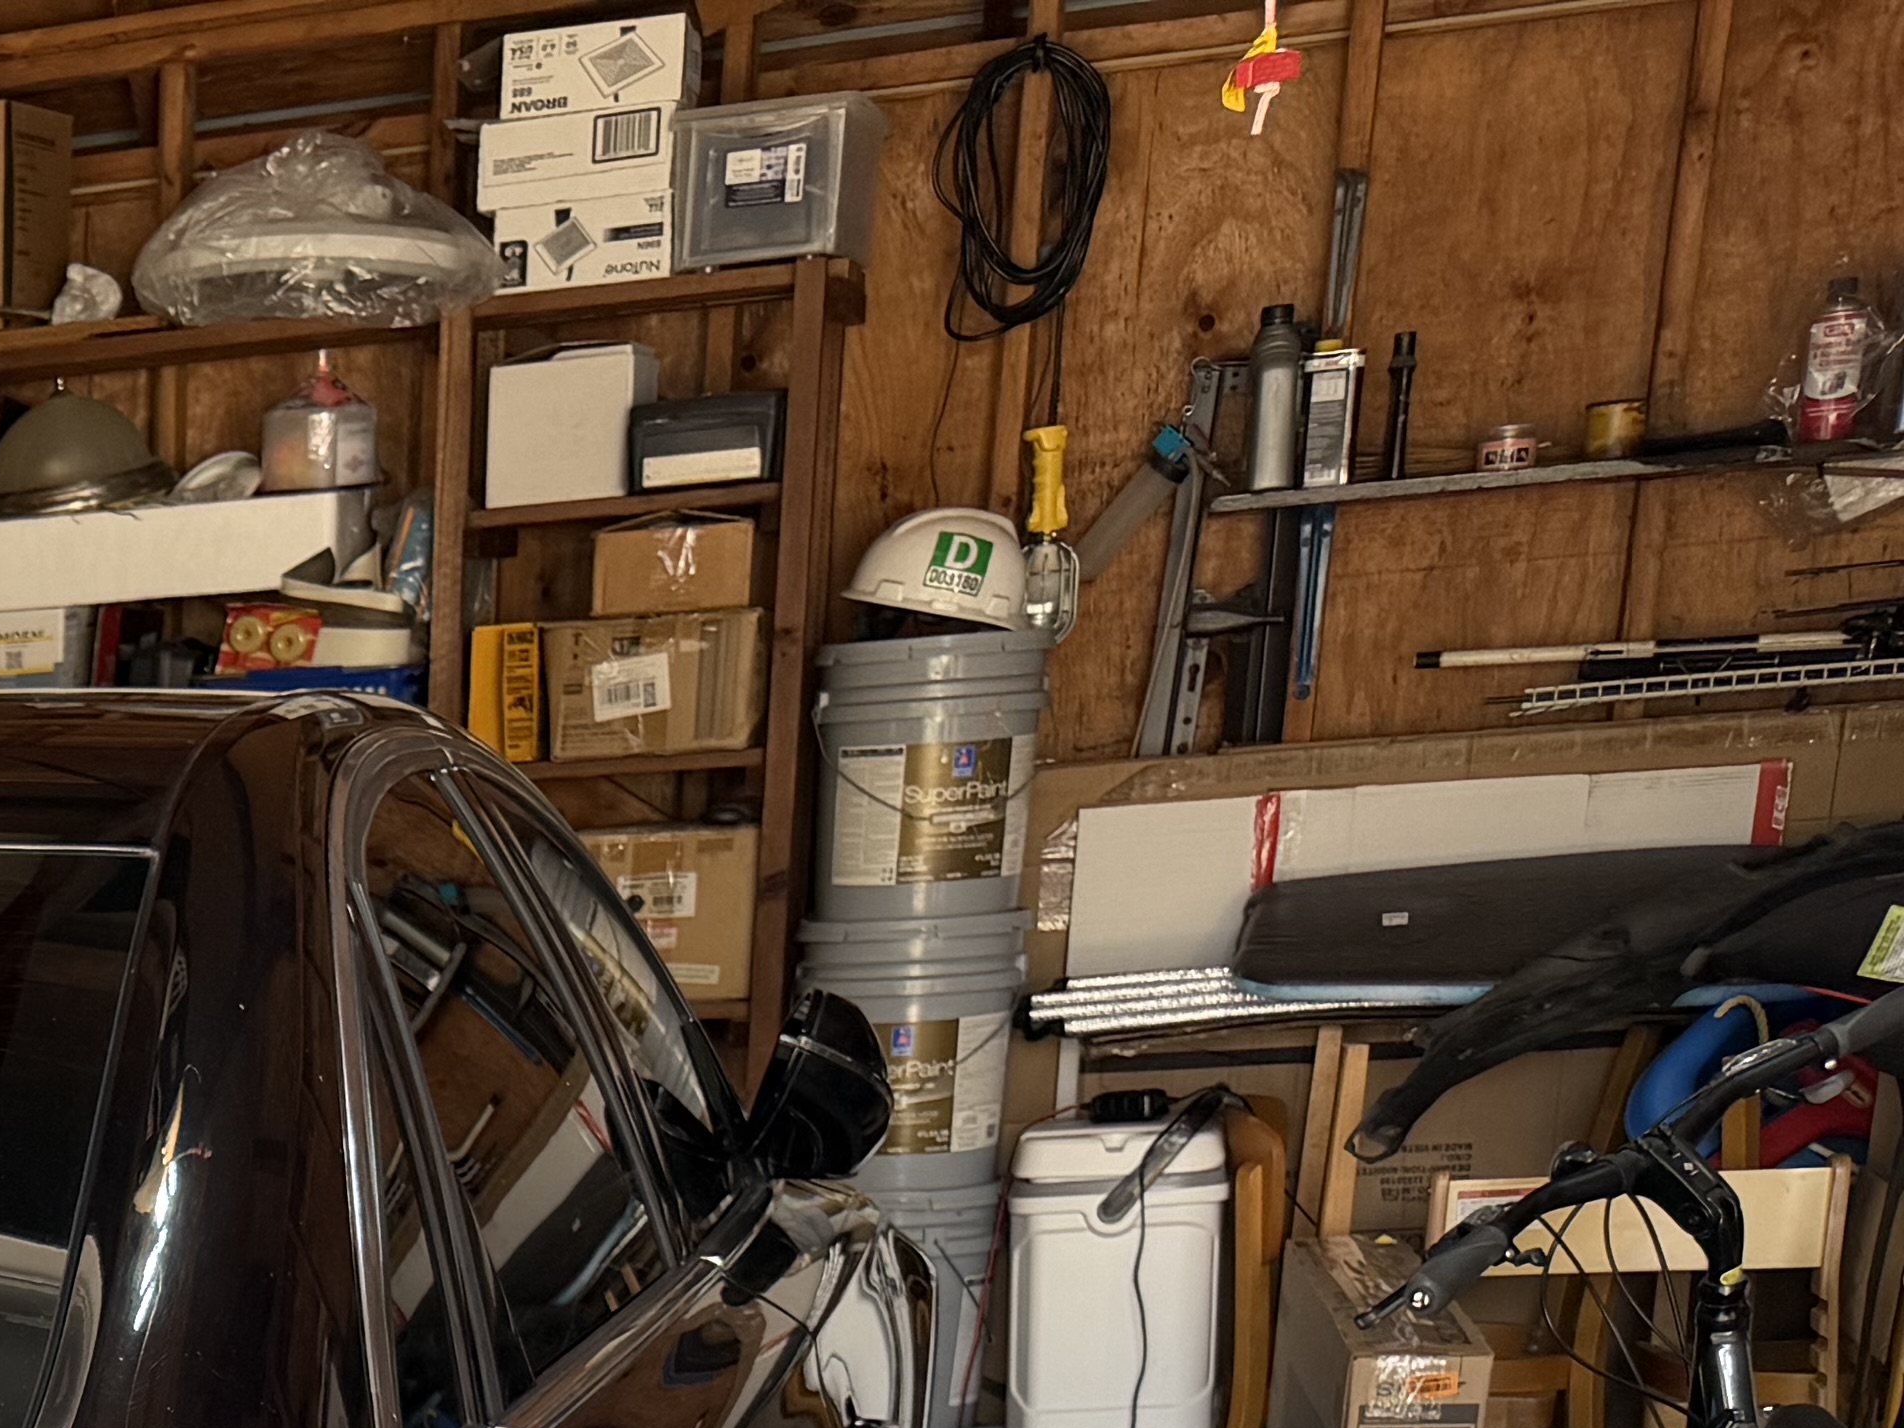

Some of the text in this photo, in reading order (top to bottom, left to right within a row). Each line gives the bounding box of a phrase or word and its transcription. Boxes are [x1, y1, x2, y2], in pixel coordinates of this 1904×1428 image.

[510, 96, 568, 114] BROAN
[604, 259, 661, 275] NuTone
[944, 534, 979, 570] D
[904, 780, 1007, 806] SuperPaint
[887, 1058, 955, 1080] erPaint
